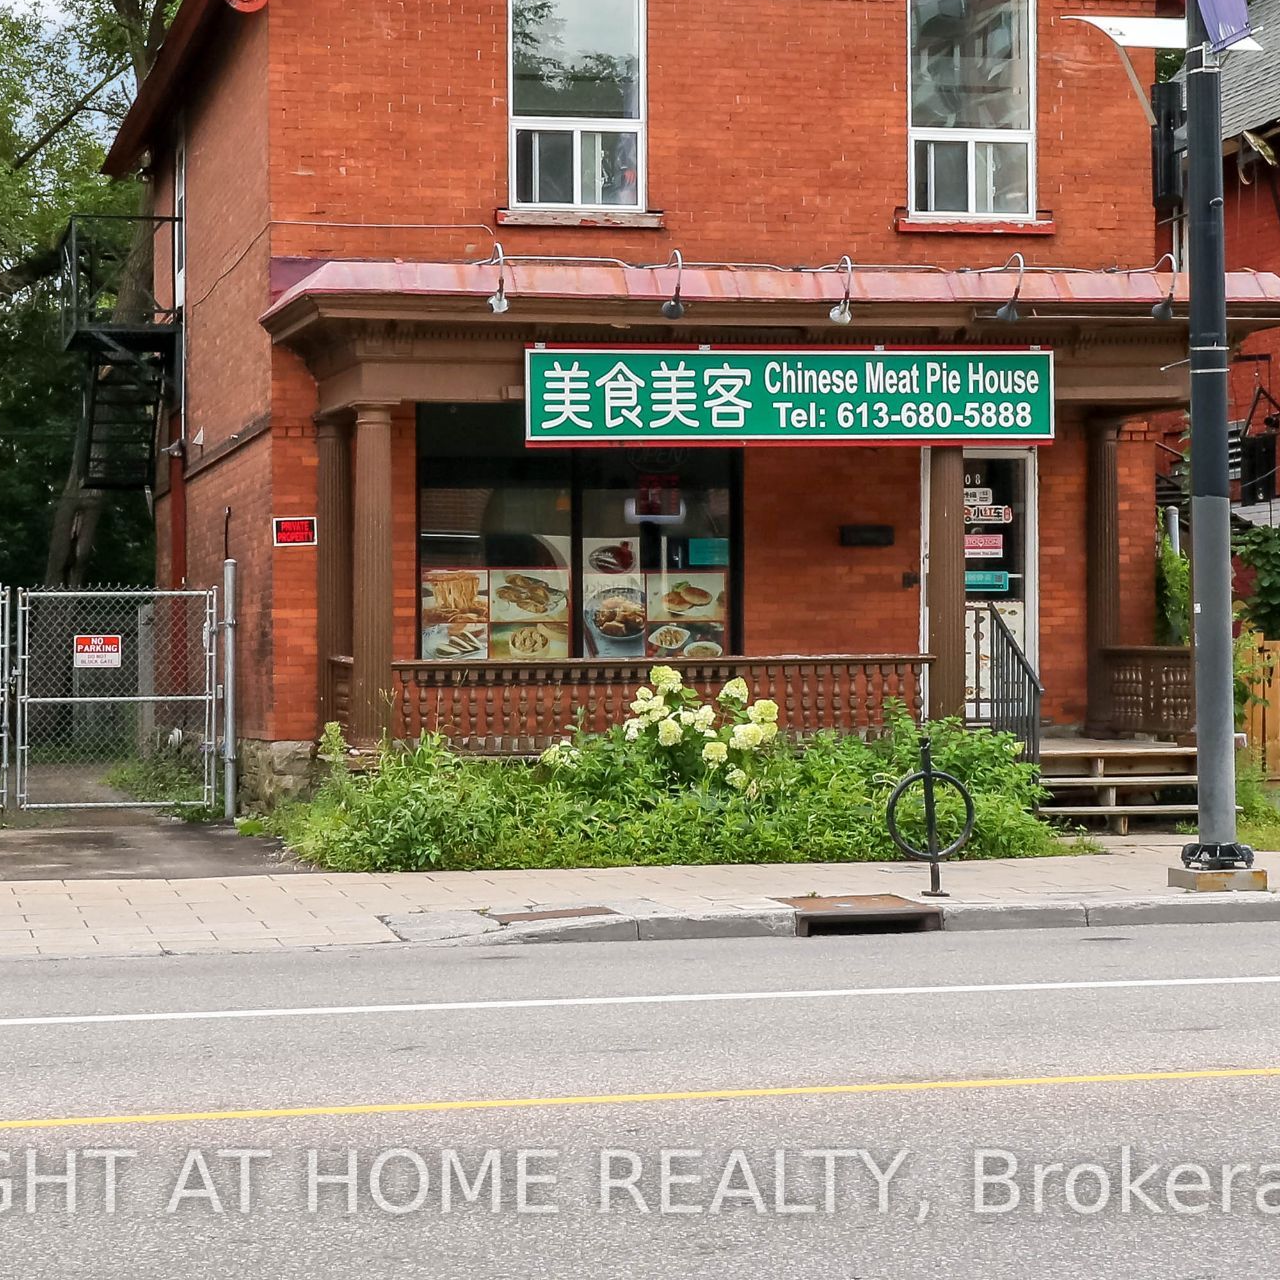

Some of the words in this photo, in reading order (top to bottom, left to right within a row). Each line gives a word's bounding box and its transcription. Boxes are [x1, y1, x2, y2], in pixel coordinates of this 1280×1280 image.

[763, 360, 859, 396] Chinese
[864, 361, 920, 395] Meat
[926, 361, 962, 395] Pie
[967, 361, 1040, 395] House
[540, 360, 754, 430] 美食美客
[772, 401, 827, 429] Tel:
[836, 401, 1033, 429] 613-680-5888
[281, 521, 309, 531] PRIVATE
[278, 532, 313, 542] PROPERTY
[91, 637, 104, 645] NO
[77, 644, 118, 652] PARKING
